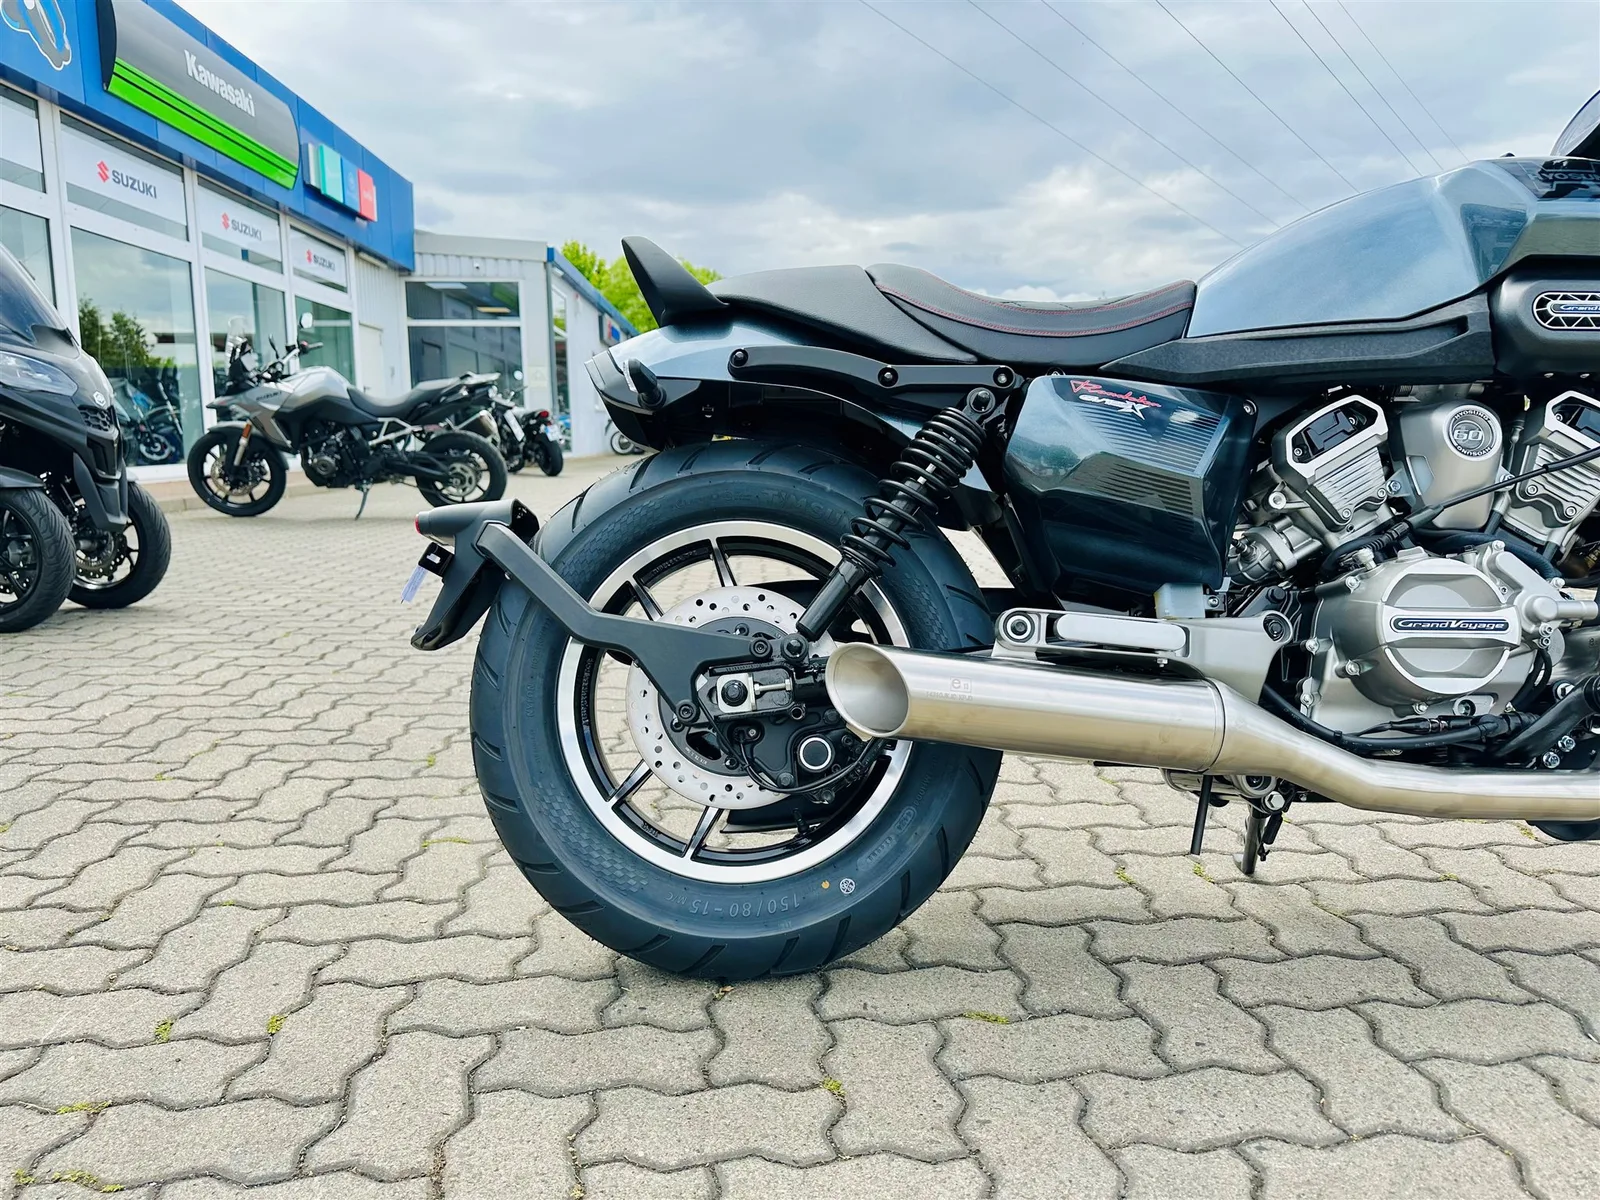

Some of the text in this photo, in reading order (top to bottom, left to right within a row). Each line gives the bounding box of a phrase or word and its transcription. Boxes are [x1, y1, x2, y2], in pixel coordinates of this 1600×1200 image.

[184, 50, 255, 117] Kawasaki
[112, 169, 157, 199] SUZUKI
[231, 219, 262, 241] SUZUKI
[313, 253, 336, 271] SUZUKI
[1453, 429, 1483, 441] 60
[1397, 619, 1505, 631] GrandVoyage
